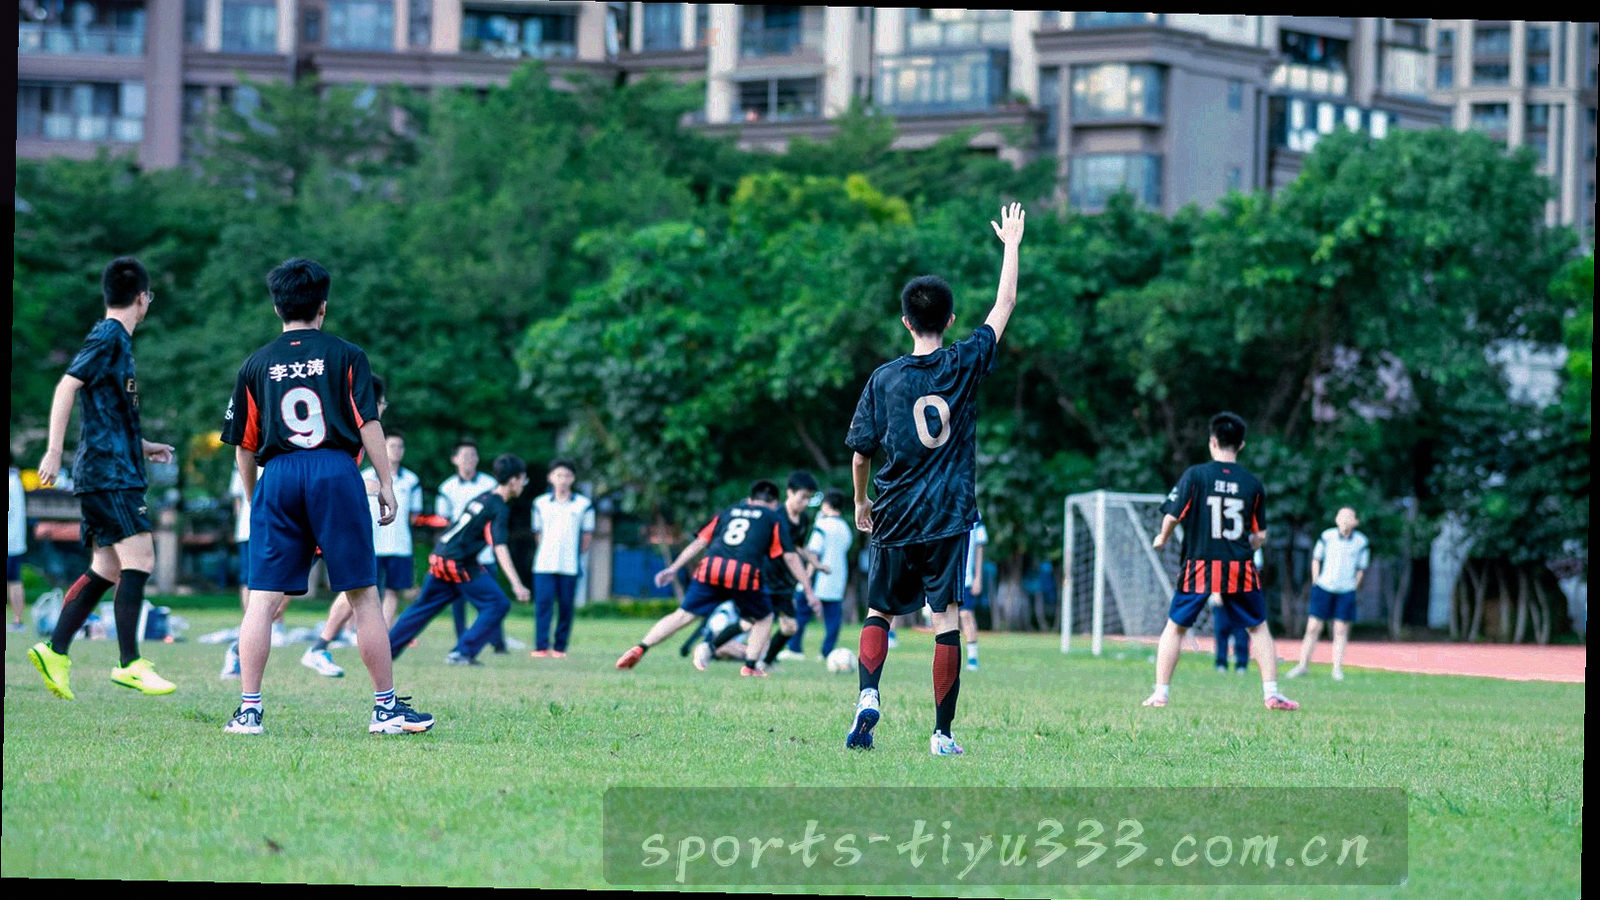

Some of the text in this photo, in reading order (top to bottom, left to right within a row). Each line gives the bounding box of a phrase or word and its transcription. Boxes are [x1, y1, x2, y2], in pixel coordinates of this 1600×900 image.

[269, 358, 325, 382] 李文涛
[281, 386, 327, 449] 9
[913, 394, 951, 449] 0
[723, 518, 750, 547] 8
[1206, 495, 1244, 541] 13
